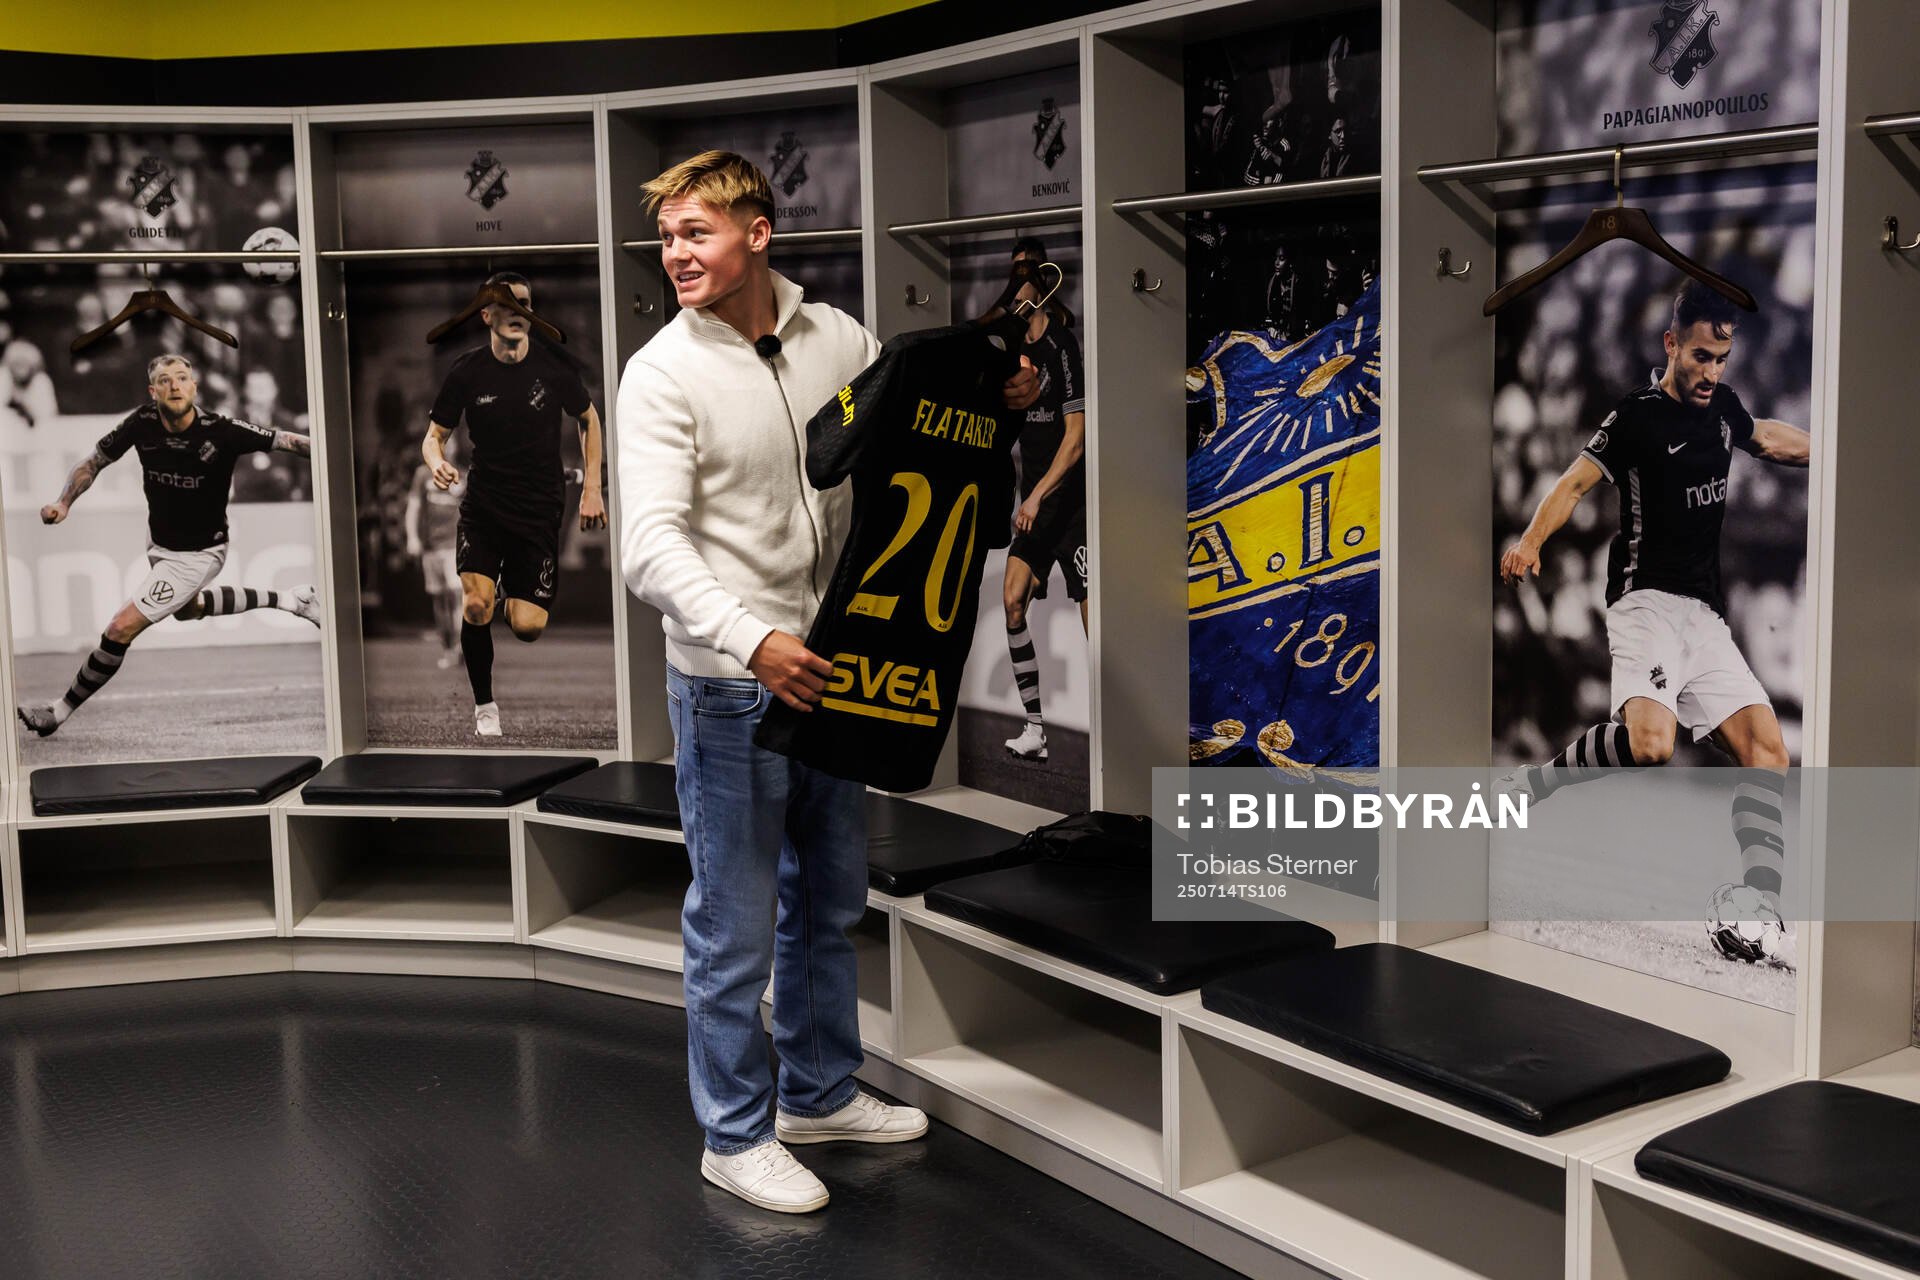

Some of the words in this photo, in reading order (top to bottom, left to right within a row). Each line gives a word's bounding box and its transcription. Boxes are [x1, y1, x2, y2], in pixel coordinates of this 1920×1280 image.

[1603, 92, 1769, 130] PAPAGIANNOPOULOS
[475, 220, 504, 232] HOVE
[776, 205, 818, 219] DERSSON
[911, 398, 997, 449] FLATAKER
[149, 470, 205, 489] notar
[1686, 476, 1728, 508] nota
[845, 472, 979, 633] 20
[824, 652, 941, 711] SVEA
